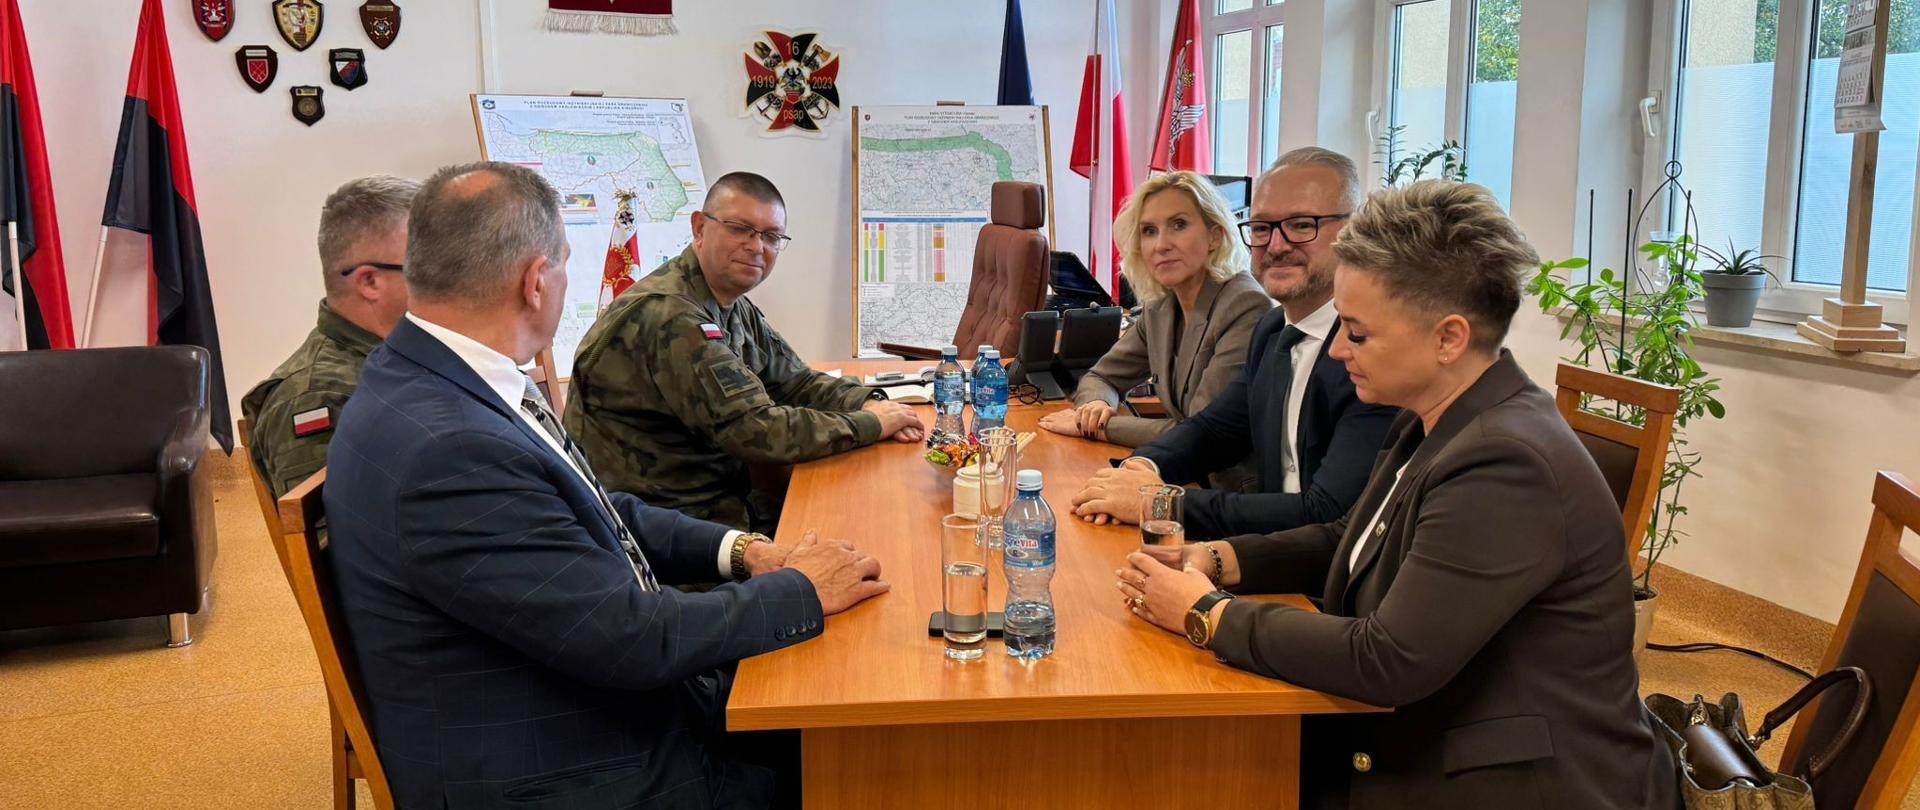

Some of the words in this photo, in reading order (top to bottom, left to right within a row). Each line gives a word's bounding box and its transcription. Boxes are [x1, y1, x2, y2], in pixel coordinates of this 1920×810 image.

[786, 42, 800, 56] 16
[752, 75, 775, 89] 1919
[811, 76, 833, 90] 2023
[783, 109, 804, 122] psap
